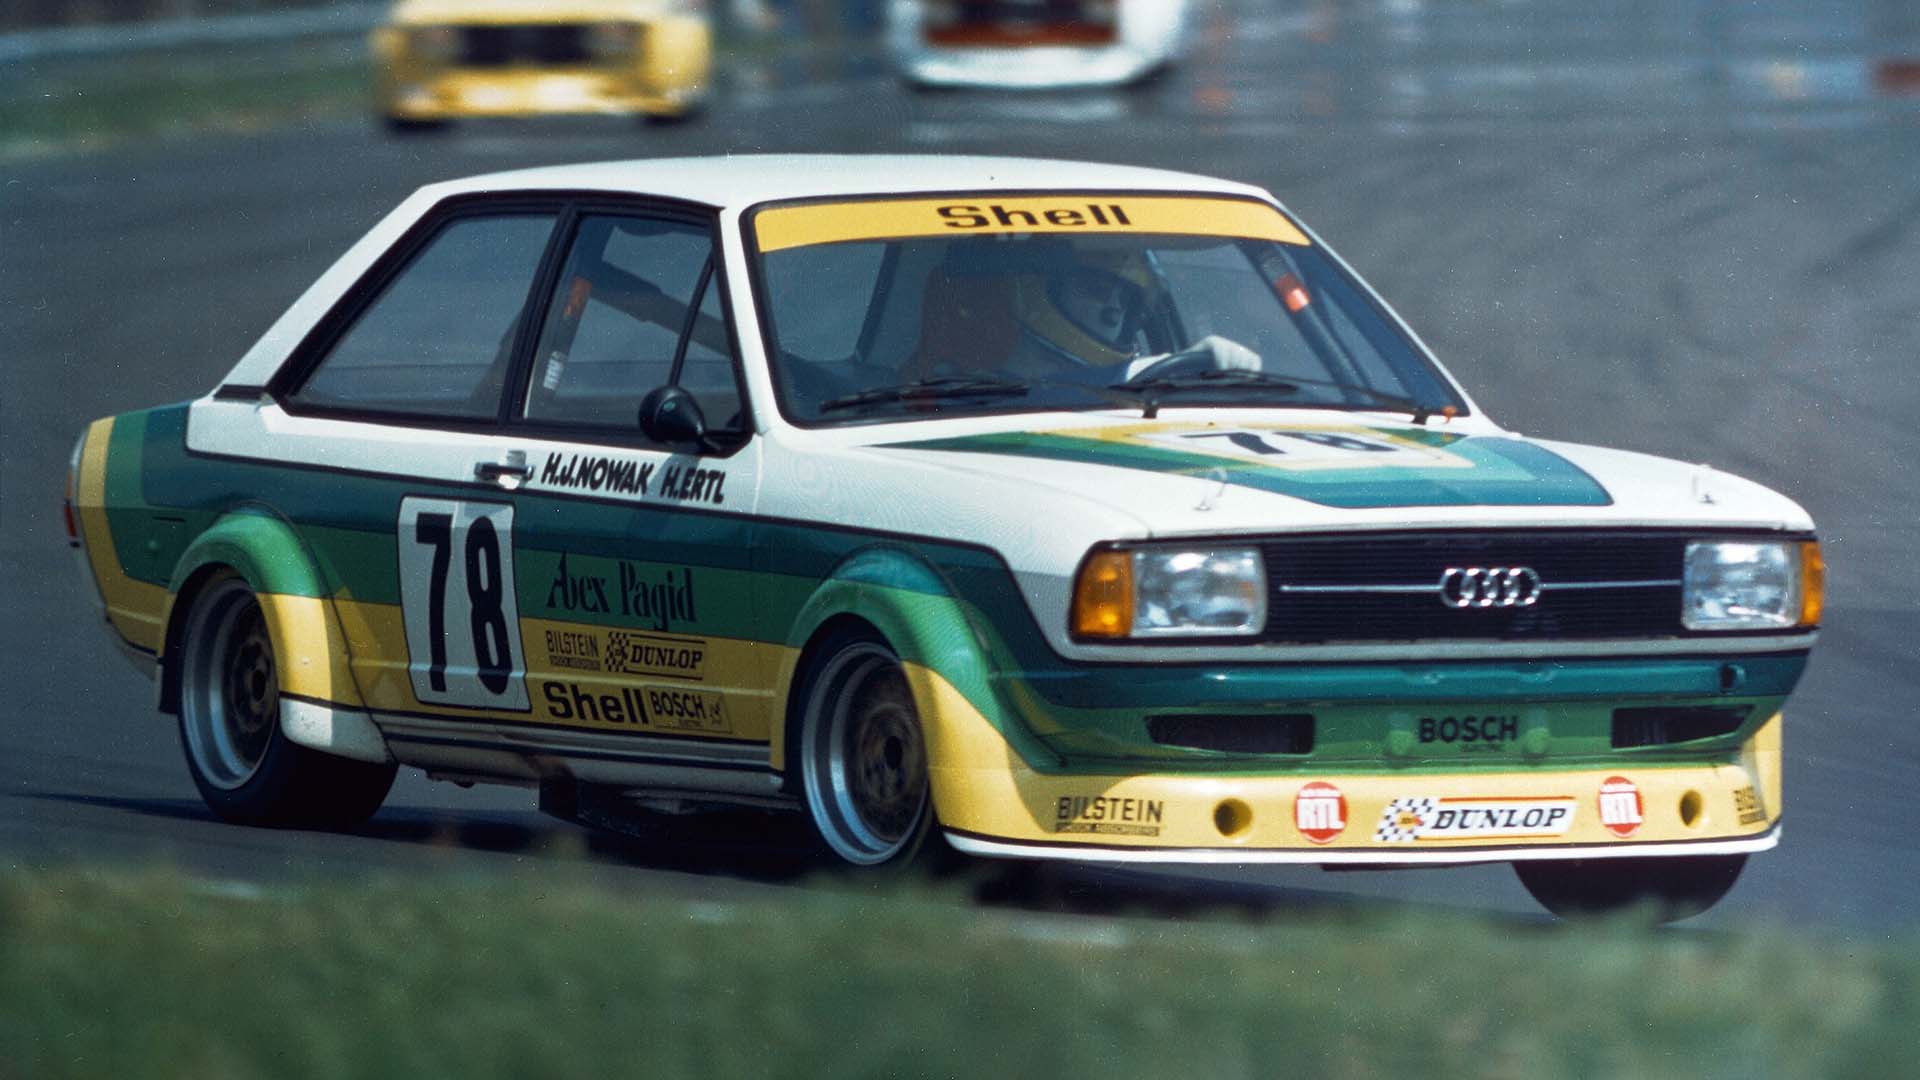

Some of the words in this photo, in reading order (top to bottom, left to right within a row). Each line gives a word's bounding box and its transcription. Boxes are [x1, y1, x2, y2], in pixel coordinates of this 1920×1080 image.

[936, 204, 1131, 229] Shell
[1179, 432, 1400, 455] 78
[541, 452, 655, 495] H.J.NOWAK
[660, 465, 726, 504] H.ERTL
[414, 511, 513, 695] 78
[618, 560, 697, 632] Pagid
[545, 630, 600, 657] BILSTEIN
[631, 644, 704, 670] DUNLOP
[543, 681, 650, 725] Shell
[650, 690, 707, 719] BOSCH
[1419, 715, 1519, 743] BOSCH
[1057, 796, 1163, 822] BILSTEIN
[1431, 807, 1567, 830] DUNLOP
